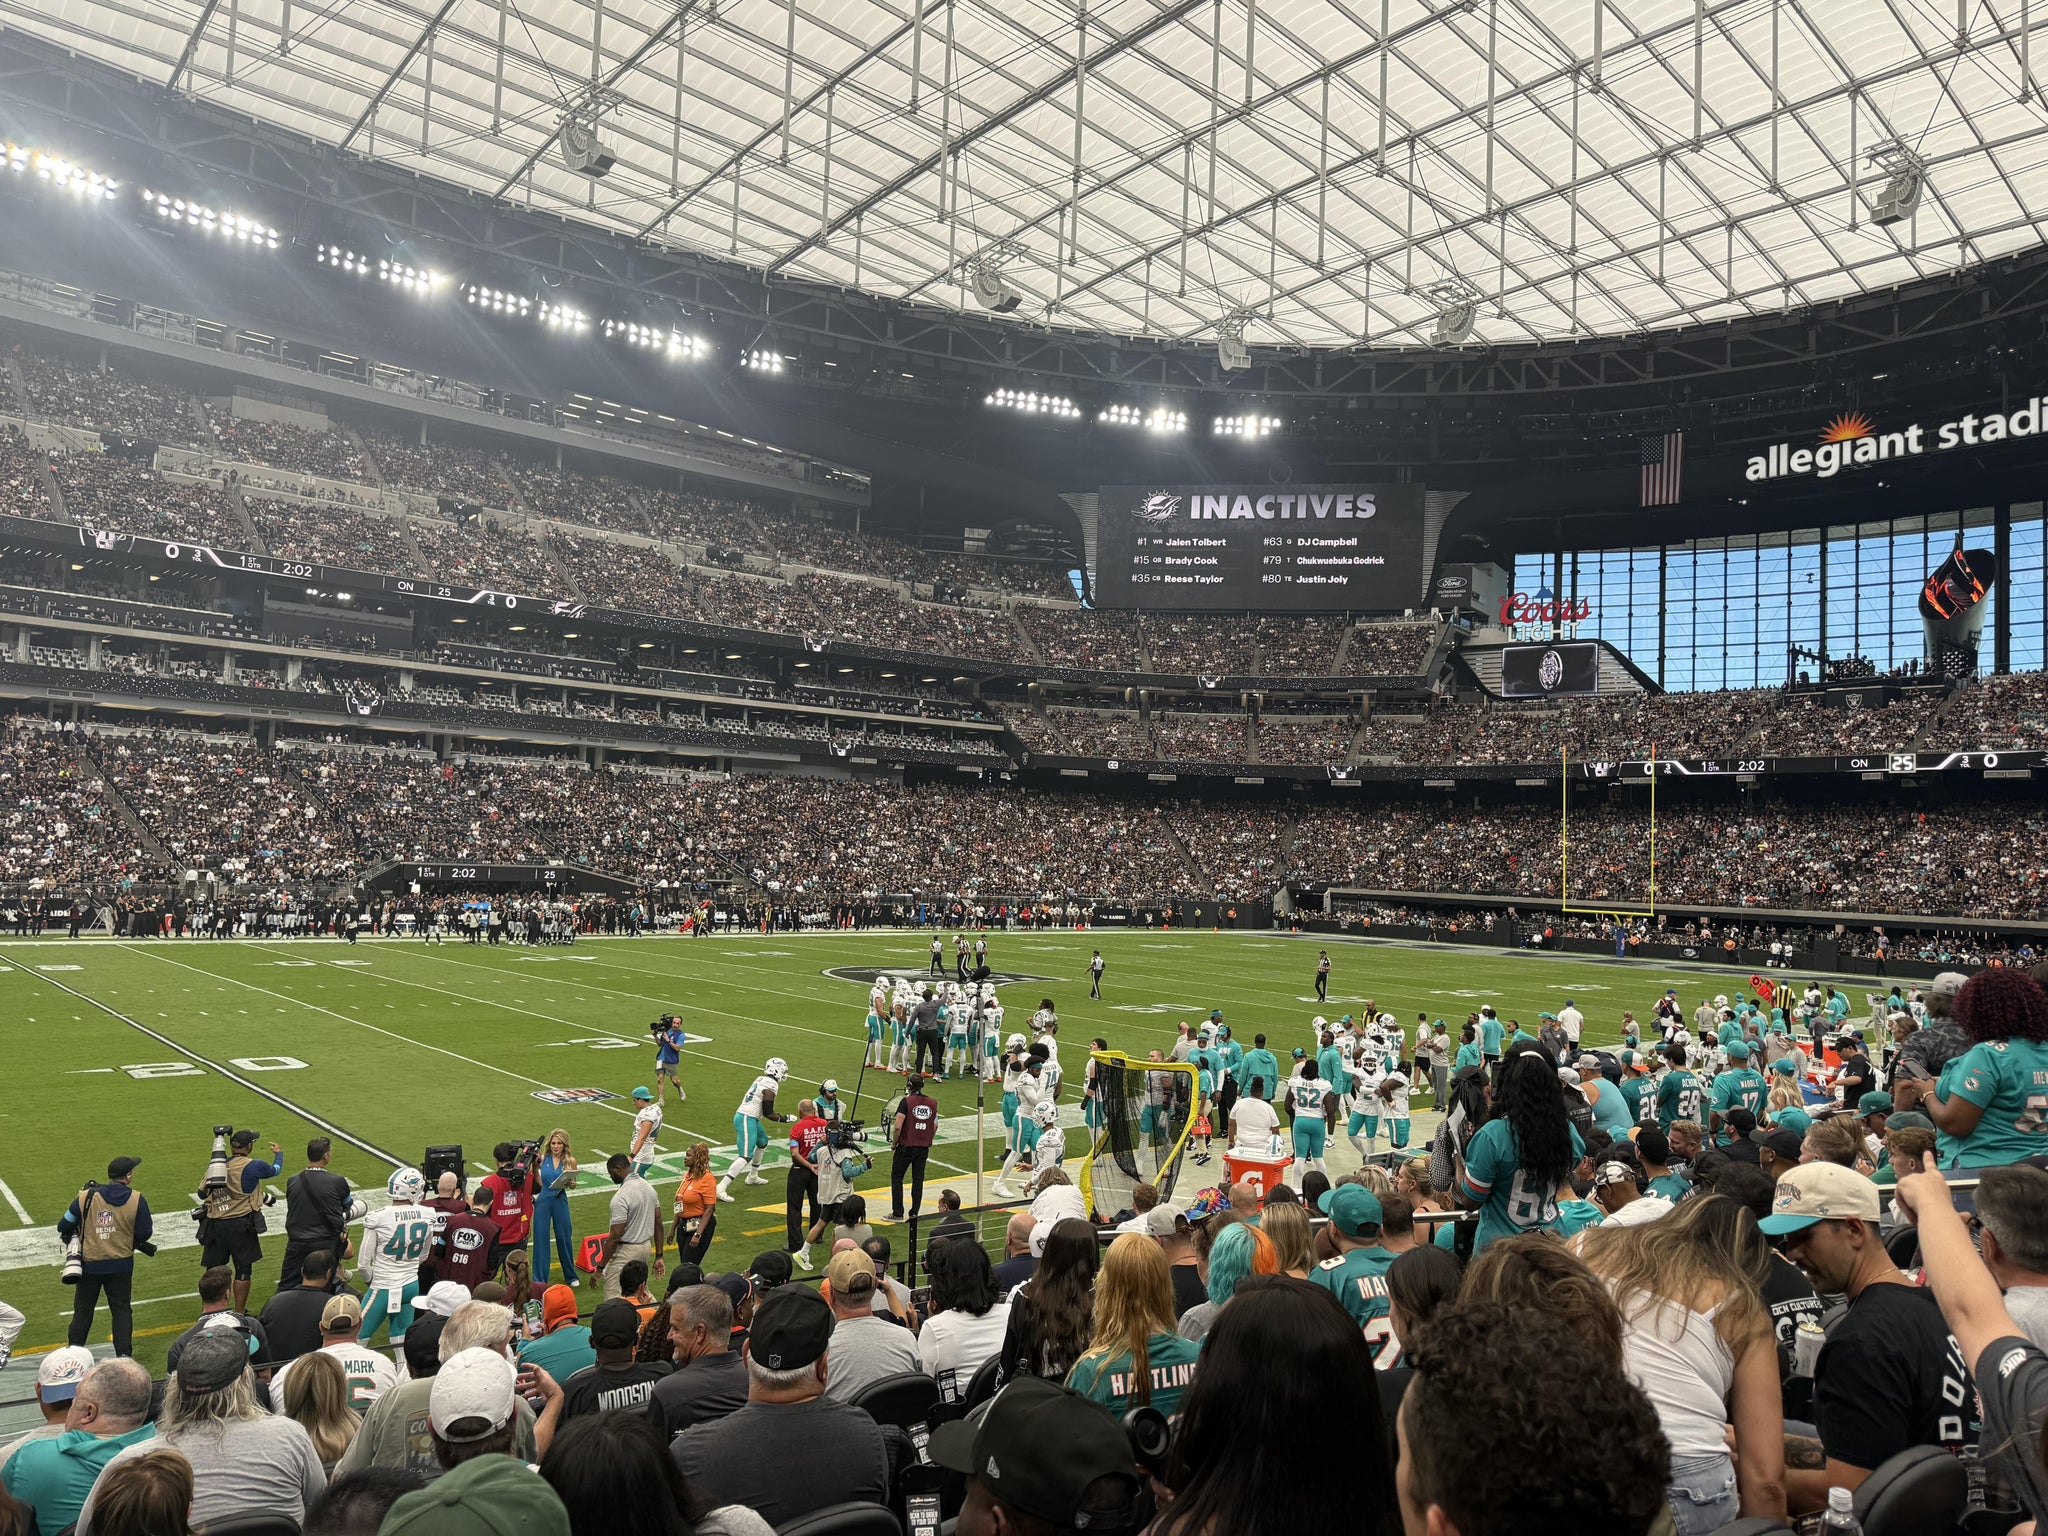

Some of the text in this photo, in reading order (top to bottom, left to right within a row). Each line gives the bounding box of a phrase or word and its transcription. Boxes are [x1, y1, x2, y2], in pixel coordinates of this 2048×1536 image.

[1745, 423, 1924, 481] allegiant
[1190, 494, 1377, 519] INACTIVES
[1137, 538, 1147, 546] #1
[1166, 538, 1191, 546] Jalen
[1192, 538, 1227, 546] Tolbert
[1263, 537, 1283, 546] #63
[1298, 538, 1311, 546] DJ
[1312, 537, 1358, 547] Campbell
[1133, 556, 1150, 564] #15
[1165, 556, 1192, 566] Brady
[1193, 556, 1218, 565] Cook
[1263, 556, 1282, 565] #79
[1296, 556, 1353, 565] Chukwuebuka
[1353, 556, 1385, 565] Godrick
[282, 562, 313, 578] 2:02
[1131, 574, 1150, 583] #35
[1164, 575, 1193, 583] Reese
[1194, 575, 1224, 585] Taylor
[1262, 574, 1281, 584] #80
[1296, 575, 1327, 584] Justin
[1327, 575, 1348, 585] Joly
[397, 581, 414, 592] ON
[438, 587, 451, 597] 25
[1498, 592, 1592, 625] Coors
[1508, 621, 1582, 643] LIGHT
[1738, 760, 1765, 772] 2:02
[1850, 759, 1869, 768] ON
[1892, 756, 1913, 771] 25
[451, 868, 476, 879] 2:02
[544, 870, 556, 880] 25
[957, 1009, 967, 1025] 5
[1739, 1079, 1760, 1088] WADDLE
[1296, 1087, 1321, 1109] 52
[1678, 1089, 1700, 1117] 28
[1741, 1091, 1759, 1113] 17
[804, 1138, 822, 1148] TEA
[1240, 1170, 1264, 1198] G
[218, 1204, 230, 1213] 112
[394, 1210, 422, 1222] PINION
[383, 1222, 428, 1262] 48
[457, 1230, 477, 1242] FOX
[452, 1252, 469, 1265] 616
[344, 1360, 375, 1374] MARK
[1110, 1362, 1197, 1397] HATLIN
[598, 1380, 655, 1412] WOODSON
